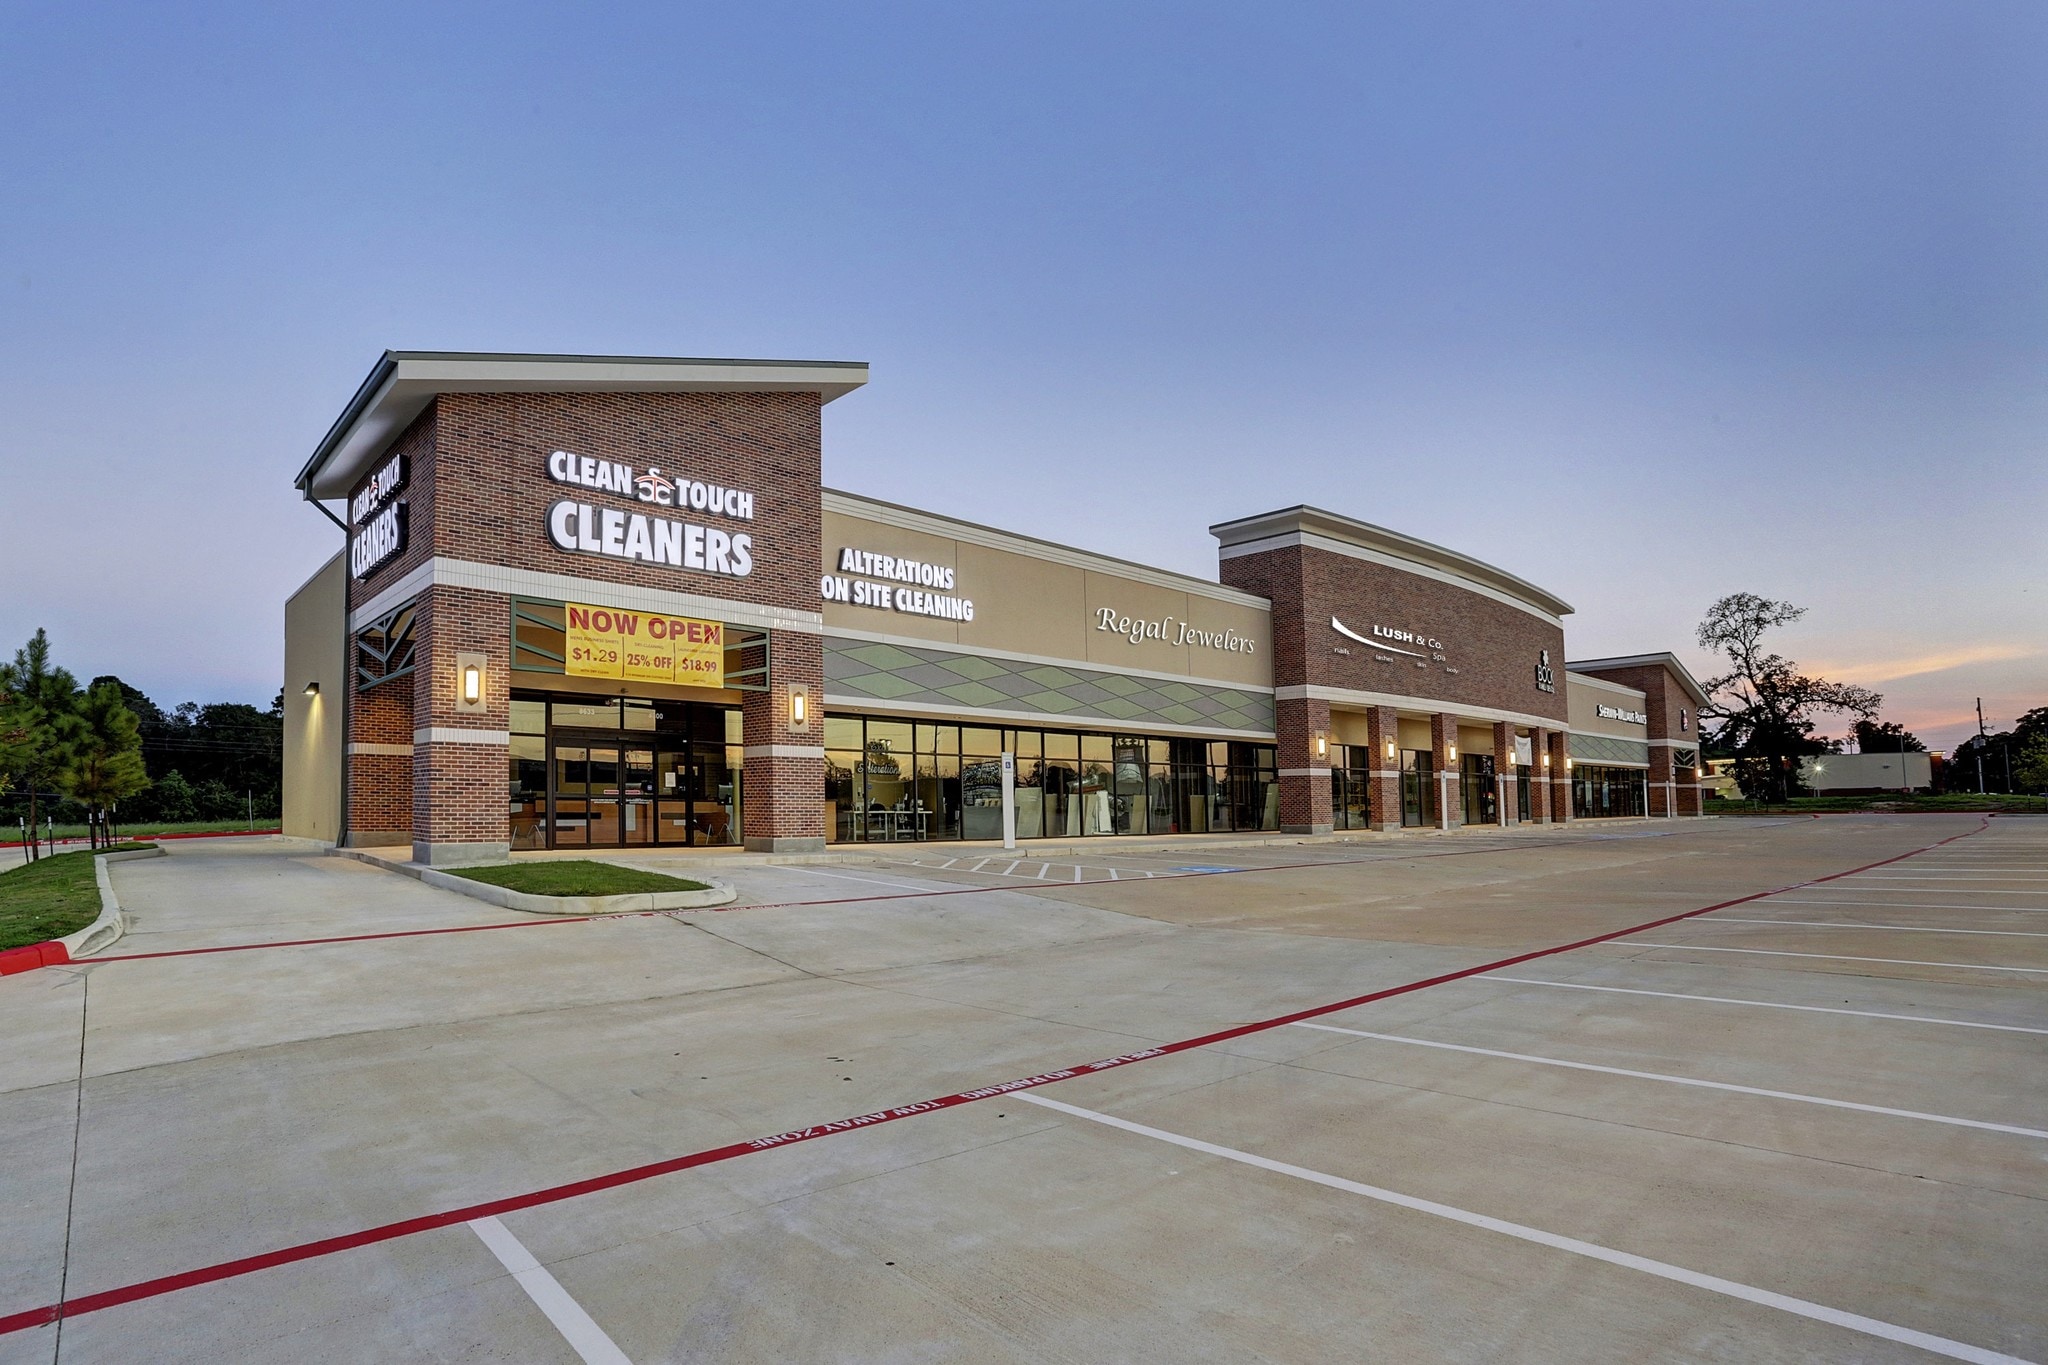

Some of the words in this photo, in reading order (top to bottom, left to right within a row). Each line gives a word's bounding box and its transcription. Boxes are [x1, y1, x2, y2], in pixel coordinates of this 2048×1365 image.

[353, 486, 370, 525] CLEAN
[378, 453, 400, 500] TOUCH
[549, 451, 632, 495] CLEAN
[675, 478, 753, 520] TOUCH
[352, 501, 398, 580] CLEANERS
[551, 500, 753, 577] CLEANERS
[841, 547, 955, 590] ALTERATIONS
[821, 575, 849, 602] ON
[854, 580, 891, 608] SITE
[895, 588, 974, 622] CLEANING
[569, 607, 639, 636] NOW
[648, 617, 721, 646] OPEN
[1096, 607, 1173, 645] Regal
[1173, 622, 1255, 655] Jewelers
[1374, 625, 1413, 643] LUSH
[1416, 635, 1425, 646] &
[1428, 638, 1444, 650] Co.
[572, 647, 618, 663] $1.29
[626, 653, 651, 668] 25%
[653, 656, 672, 669] OFF
[682, 657, 717, 673] $18.99
[1432, 652, 1446, 662] Spa
[1086, 1055, 1131, 1070] LANE
[1126, 1048, 1167, 1060] FIRE
[1045, 1069, 1075, 1080] NO
[959, 1076, 1045, 1100] PARKING
[894, 1100, 944, 1117] TOW
[825, 1112, 887, 1132] AWAY
[746, 1127, 820, 1149] ZONE
